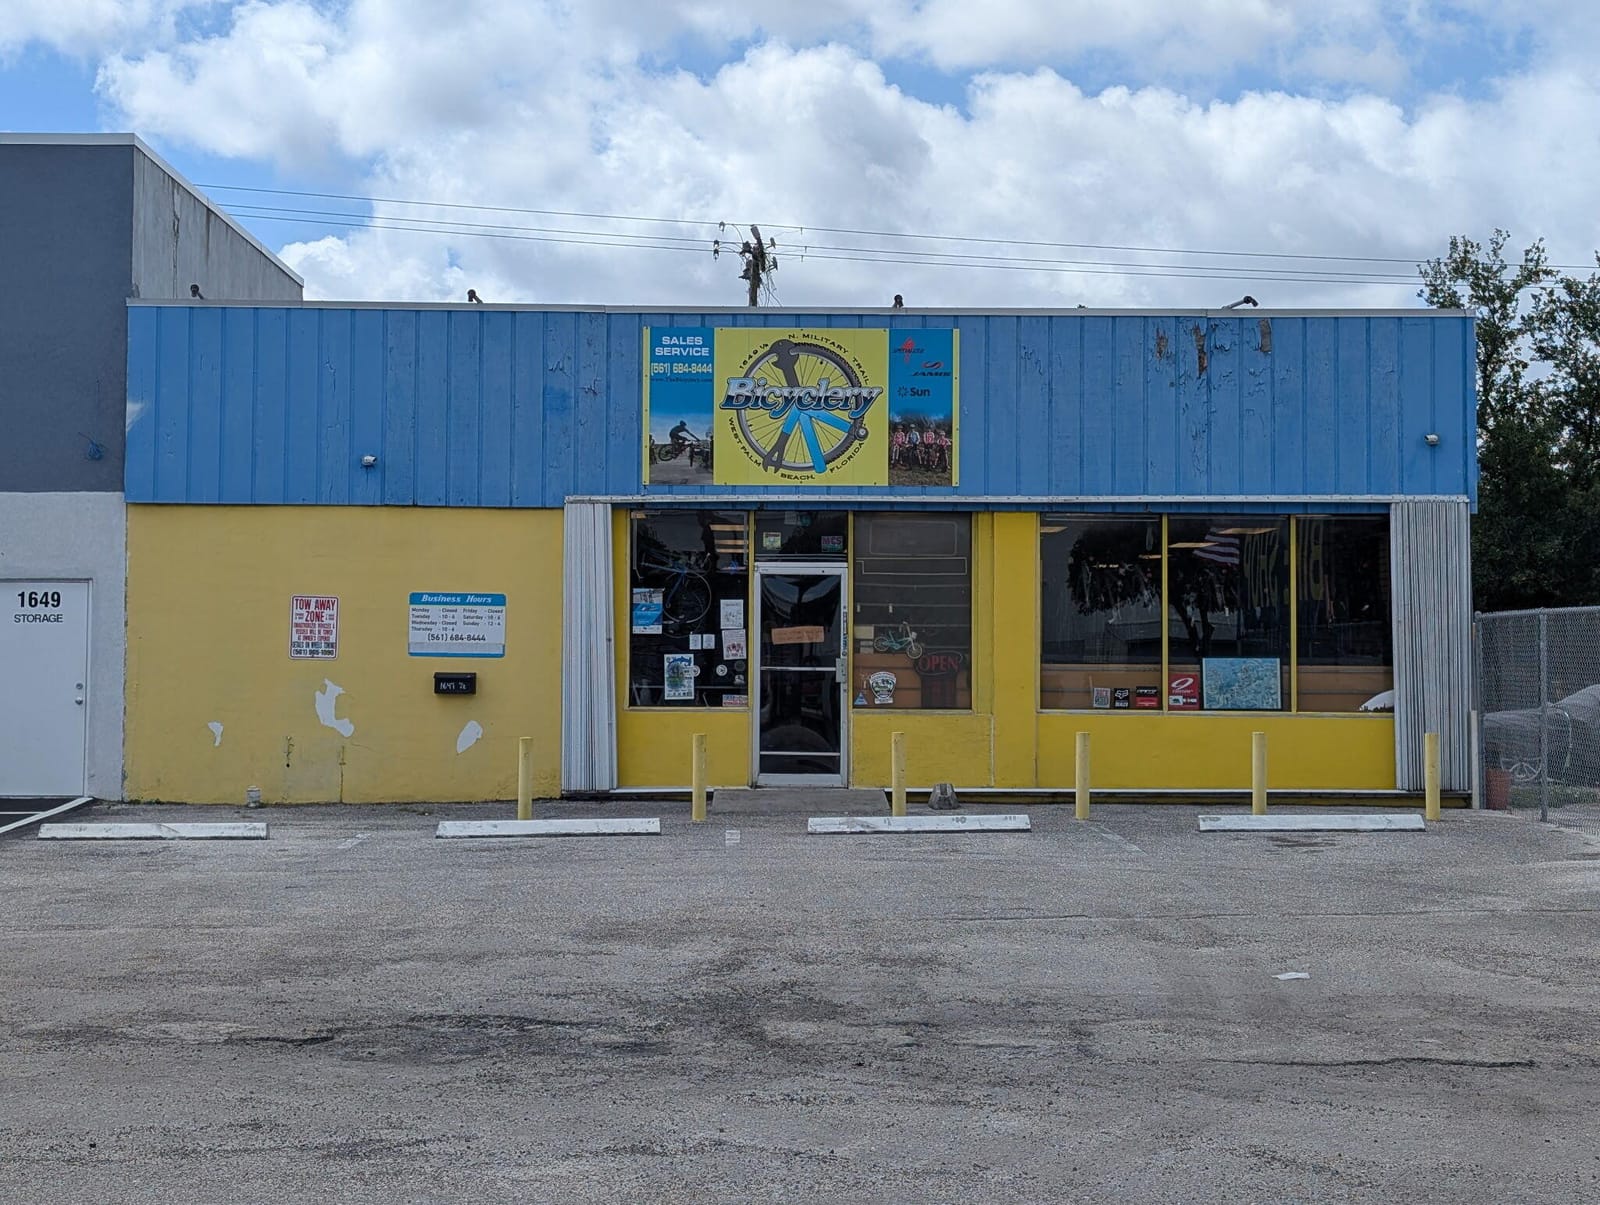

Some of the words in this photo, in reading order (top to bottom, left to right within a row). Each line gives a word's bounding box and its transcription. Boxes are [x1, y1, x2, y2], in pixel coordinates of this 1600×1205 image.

[662, 336, 703, 345] SALES
[655, 347, 710, 356] SERVICE
[802, 333, 849, 354] MILITARY
[852, 356, 870, 385] TRAIL
[651, 362, 671, 376] (561)
[719, 376, 884, 419] Bicyclery
[909, 387, 930, 397] Sun
[728, 417, 742, 444] WEST
[740, 445, 761, 467] PALM
[829, 441, 865, 473] FLORIDA
[17, 591, 61, 608] 1649
[295, 598, 312, 610] TOW
[314, 599, 336, 611] AWAY
[421, 595, 460, 603] Business
[466, 595, 492, 603] Hours
[14, 614, 63, 623] STORAGE
[305, 611, 325, 622] ZONE
[428, 633, 447, 642] (561)
[449, 633, 486, 641] 684-8444
[919, 655, 959, 672] OPEN
